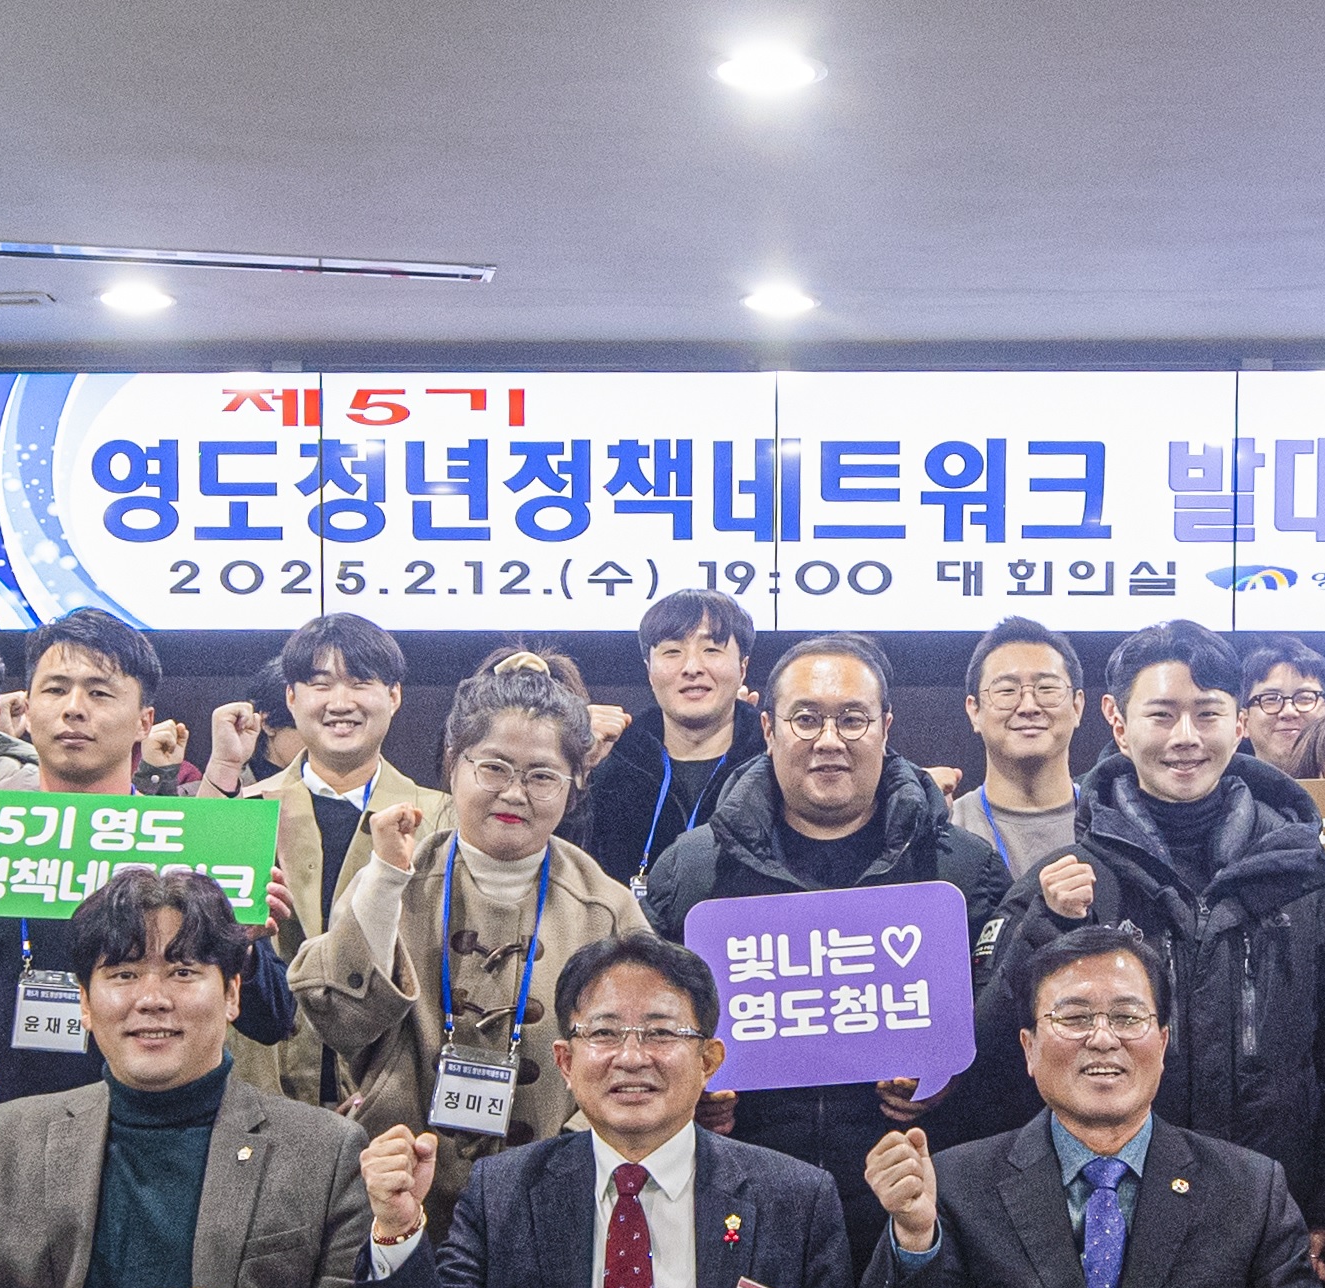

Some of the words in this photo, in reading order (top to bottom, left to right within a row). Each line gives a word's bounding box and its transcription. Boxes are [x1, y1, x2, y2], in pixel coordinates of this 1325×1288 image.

[90, 437, 1113, 543] 영도청년정책네트워크
[168, 558, 661, 600] 2025.2.12.(수)
[695, 559, 893, 597] 19:00
[90, 808, 186, 853] 영도
[726, 927, 876, 983] 빛나는
[728, 979, 932, 1042] 영도청년
